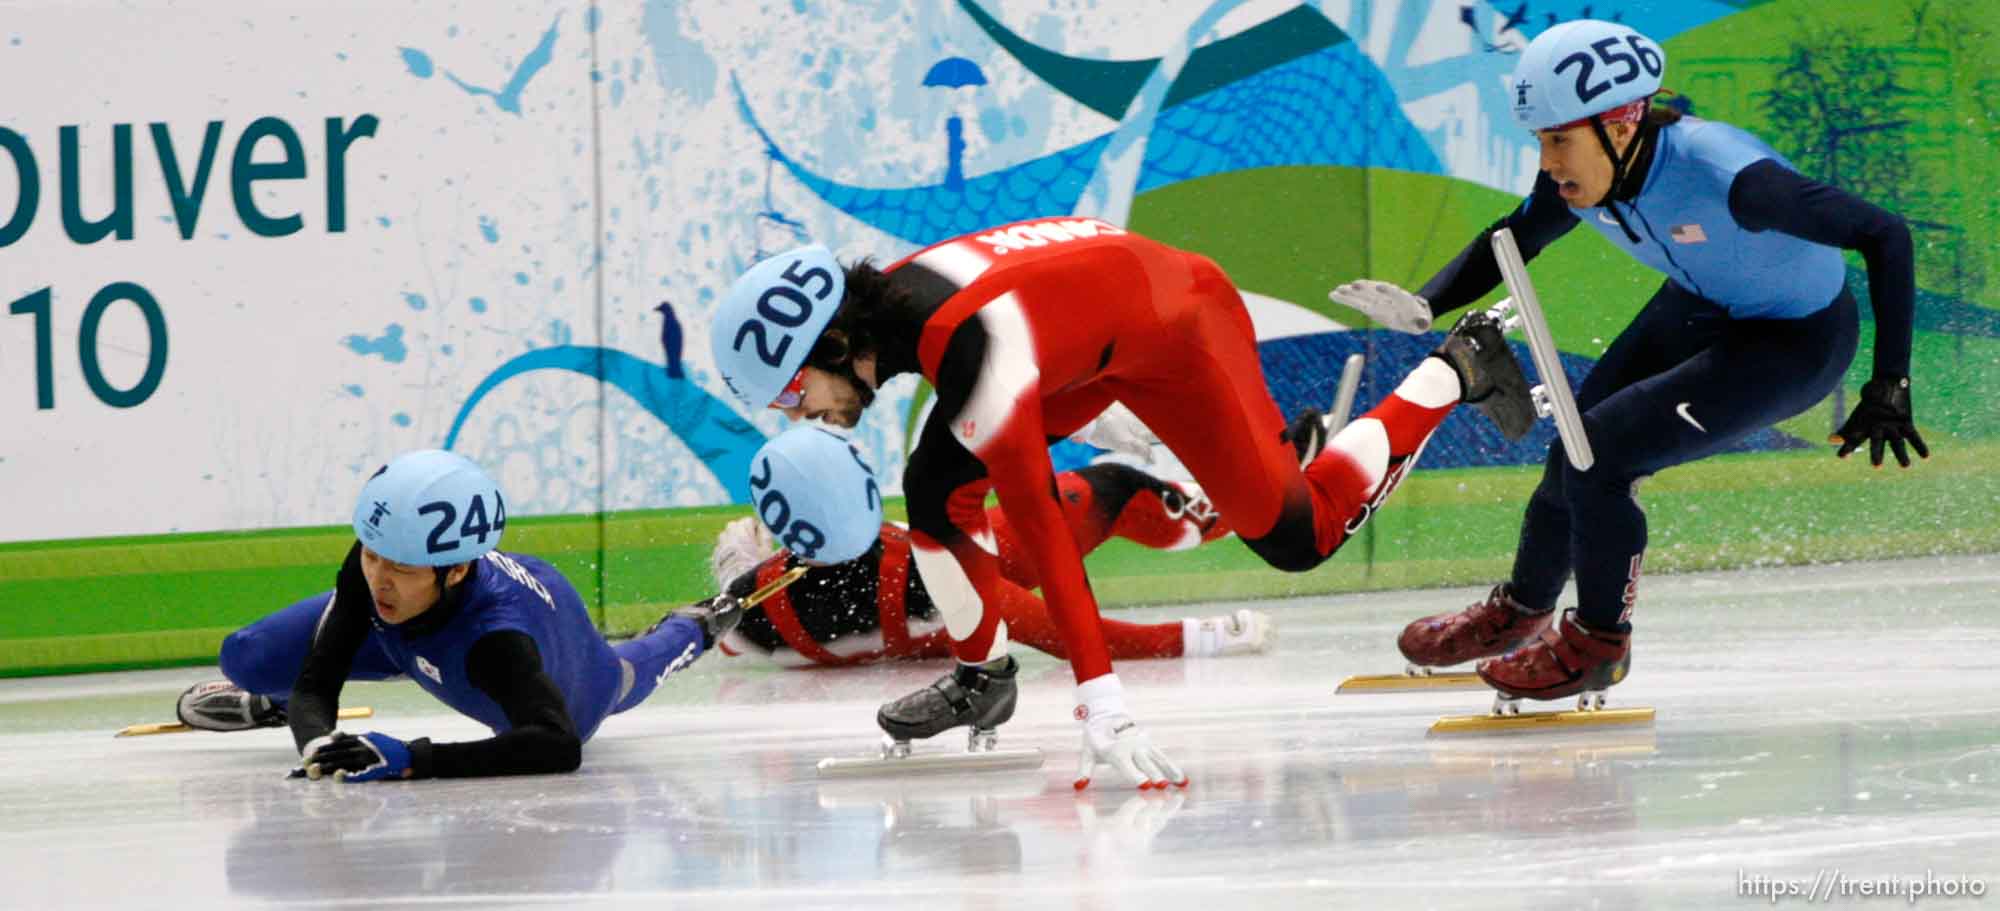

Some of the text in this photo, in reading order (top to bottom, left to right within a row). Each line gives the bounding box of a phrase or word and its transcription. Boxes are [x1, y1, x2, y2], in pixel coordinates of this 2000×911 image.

[1553, 34, 1662, 104] 256
[9, 281, 169, 410] 10
[733, 259, 834, 368] 205
[417, 489, 506, 554] 244
